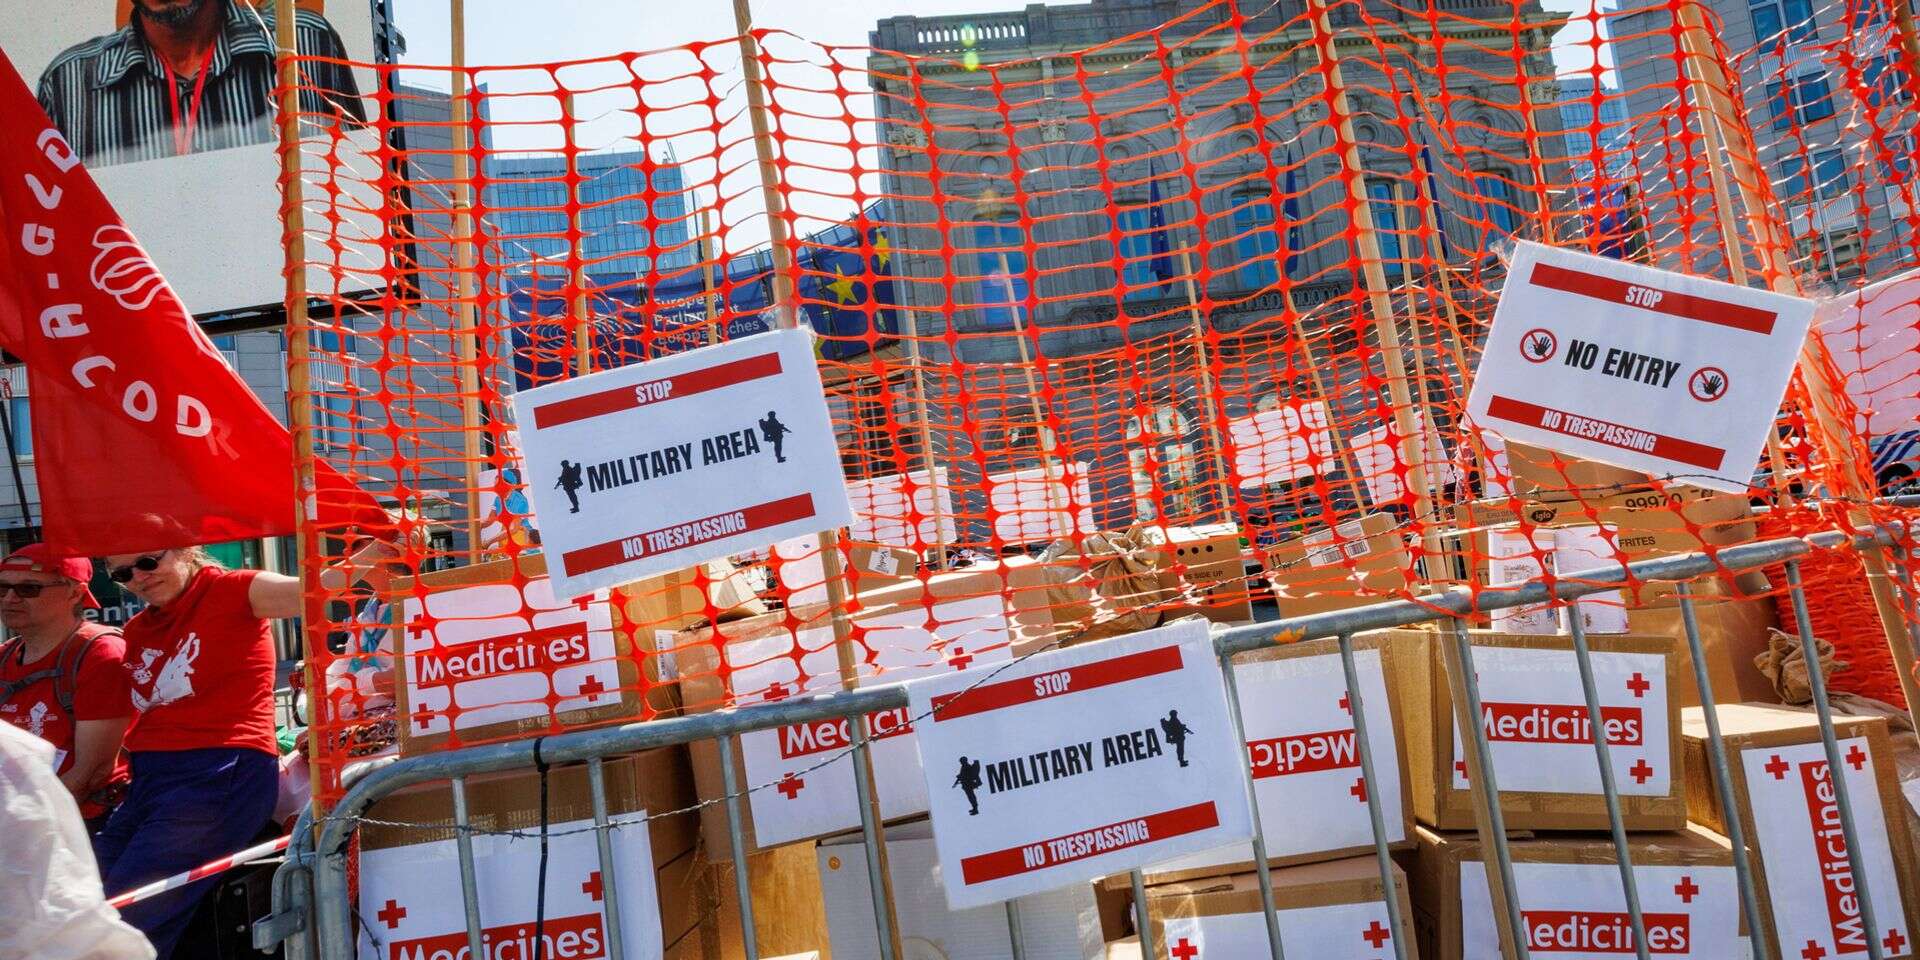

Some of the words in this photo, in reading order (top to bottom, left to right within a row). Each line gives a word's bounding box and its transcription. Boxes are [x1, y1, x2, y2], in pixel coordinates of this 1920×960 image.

[1625, 285, 1663, 308] STOP
[1564, 339, 1599, 370] NO
[1601, 348, 1681, 389] ENTRY
[635, 380, 673, 404] STOP
[1541, 410, 1560, 429] NO
[1564, 415, 1658, 452] TRESPASSING
[586, 442, 692, 493] MILITARY
[701, 428, 761, 466] AREA
[622, 538, 644, 559] NO
[648, 512, 747, 553] TRESPASSING
[1619, 536, 1656, 548] FRITES
[1033, 672, 1072, 697] STOP
[985, 742, 1093, 794] MILITARY
[1102, 728, 1163, 768] AREA
[1023, 846, 1046, 869] NO
[1048, 820, 1150, 863] TRESPASSING
